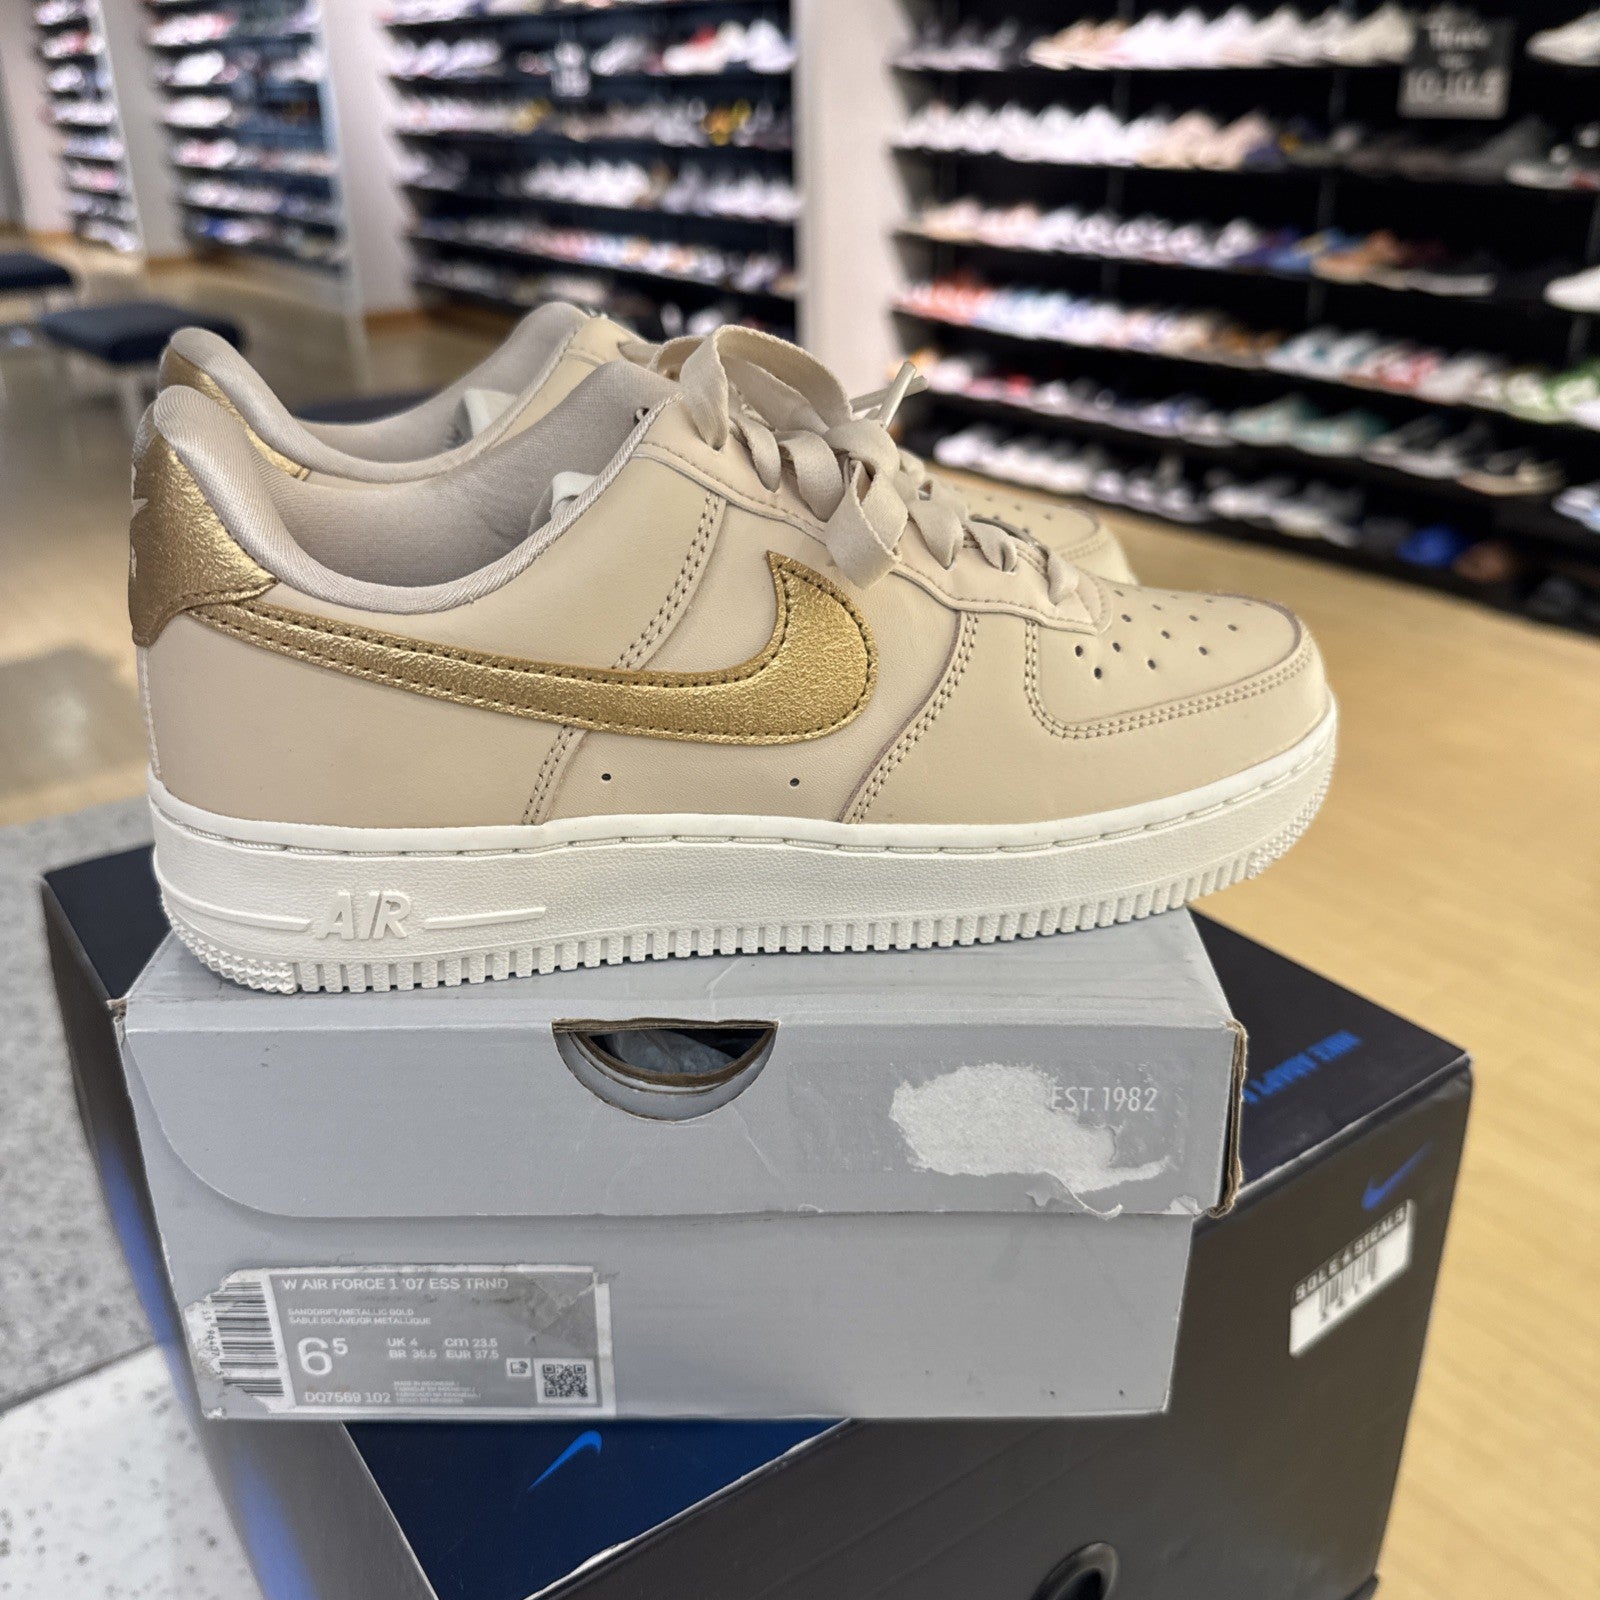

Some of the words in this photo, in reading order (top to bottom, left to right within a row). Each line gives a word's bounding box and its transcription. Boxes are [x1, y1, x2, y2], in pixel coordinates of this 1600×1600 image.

[316, 889, 411, 940] AIR
[1051, 1086, 1096, 1112] EST.
[1102, 1086, 1158, 1112] 1982
[281, 1279, 297, 1290] W
[302, 1278, 329, 1290] AIR
[332, 1278, 386, 1290] FORCE
[390, 1278, 399, 1290] 1
[402, 1278, 425, 1290] '07
[429, 1277, 461, 1290] ESS
[464, 1277, 509, 1290] TRND
[387, 1337, 407, 1347] UK
[410, 1338, 418, 1347] 4
[388, 1350, 407, 1359] BR
[446, 1350, 472, 1359] EUR
[475, 1350, 500, 1359] 37.5
[364, 1391, 391, 1403] 102
